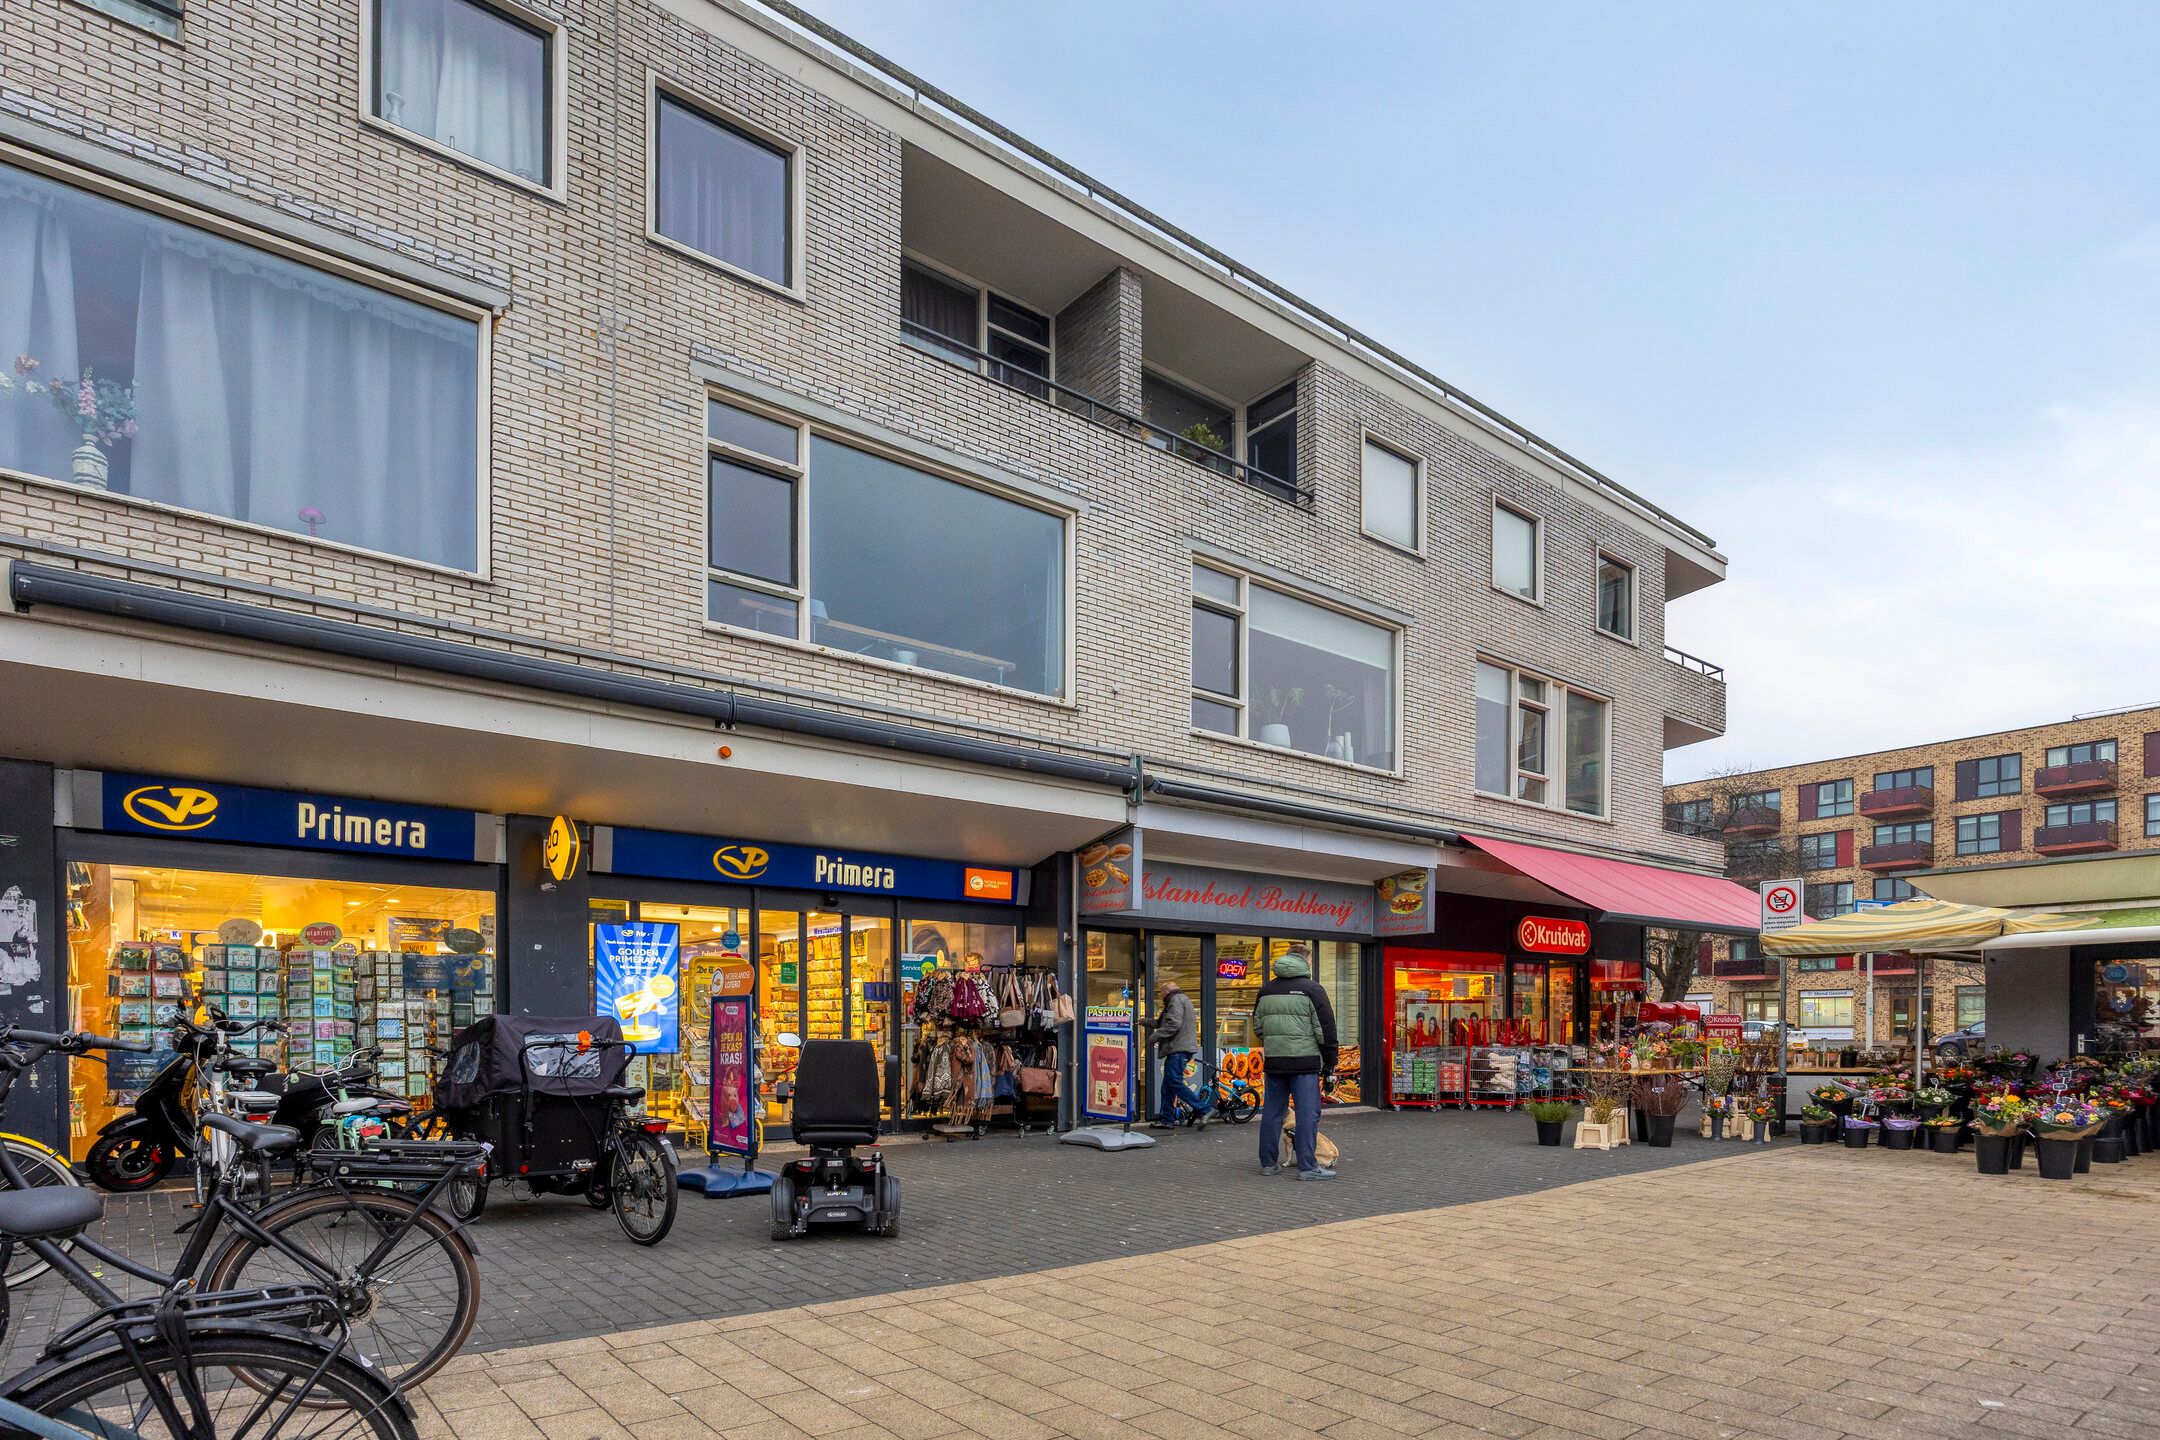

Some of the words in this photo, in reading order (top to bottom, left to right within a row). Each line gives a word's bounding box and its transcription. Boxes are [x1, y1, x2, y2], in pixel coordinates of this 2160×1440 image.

[298, 802, 426, 849] Primera
[815, 855, 895, 889] Primera
[1256, 885, 1356, 927] Bakkerij
[1537, 925, 1586, 947] Kruidvat
[617, 947, 659, 956] GOUDEN
[609, 955, 668, 965] PRIMERAPAS
[1220, 963, 1247, 976] OPEN
[725, 970, 751, 980] NEDERLANDSE
[724, 980, 741, 989] LOTERIJ
[1088, 1008, 1131, 1017] PASFOTO'S
[720, 1032, 735, 1042] SPEK
[1708, 1028, 1738, 1037] ACTIE!
[1106, 1037, 1124, 1046] Primera
[727, 1042, 743, 1052] KAS?
[720, 1052, 743, 1065] KRAS!
